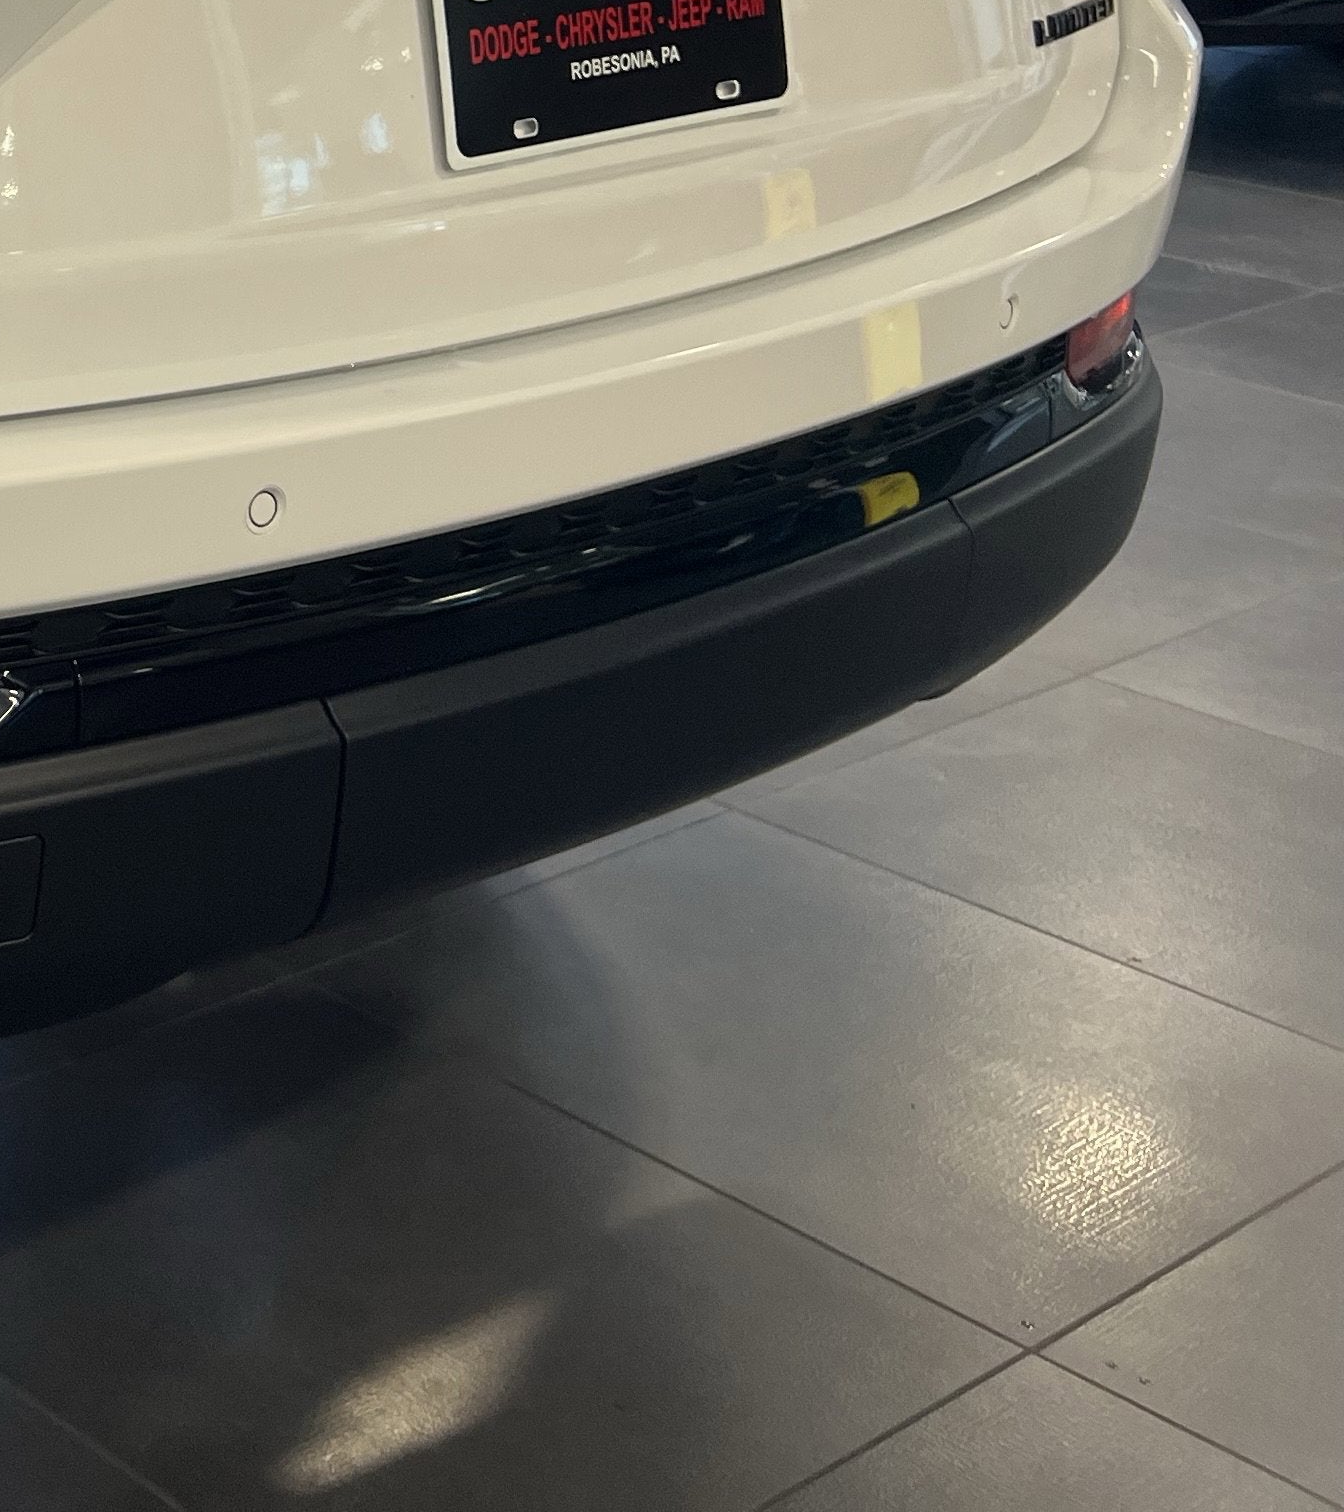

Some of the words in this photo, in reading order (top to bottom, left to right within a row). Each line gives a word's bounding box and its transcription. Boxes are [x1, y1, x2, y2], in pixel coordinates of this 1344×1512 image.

[469, 19, 542, 65] DODGE
[555, 0, 655, 51] CHRYSLER
[570, 49, 659, 81] ROBESONIA,
[661, 45, 681, 64] PA
